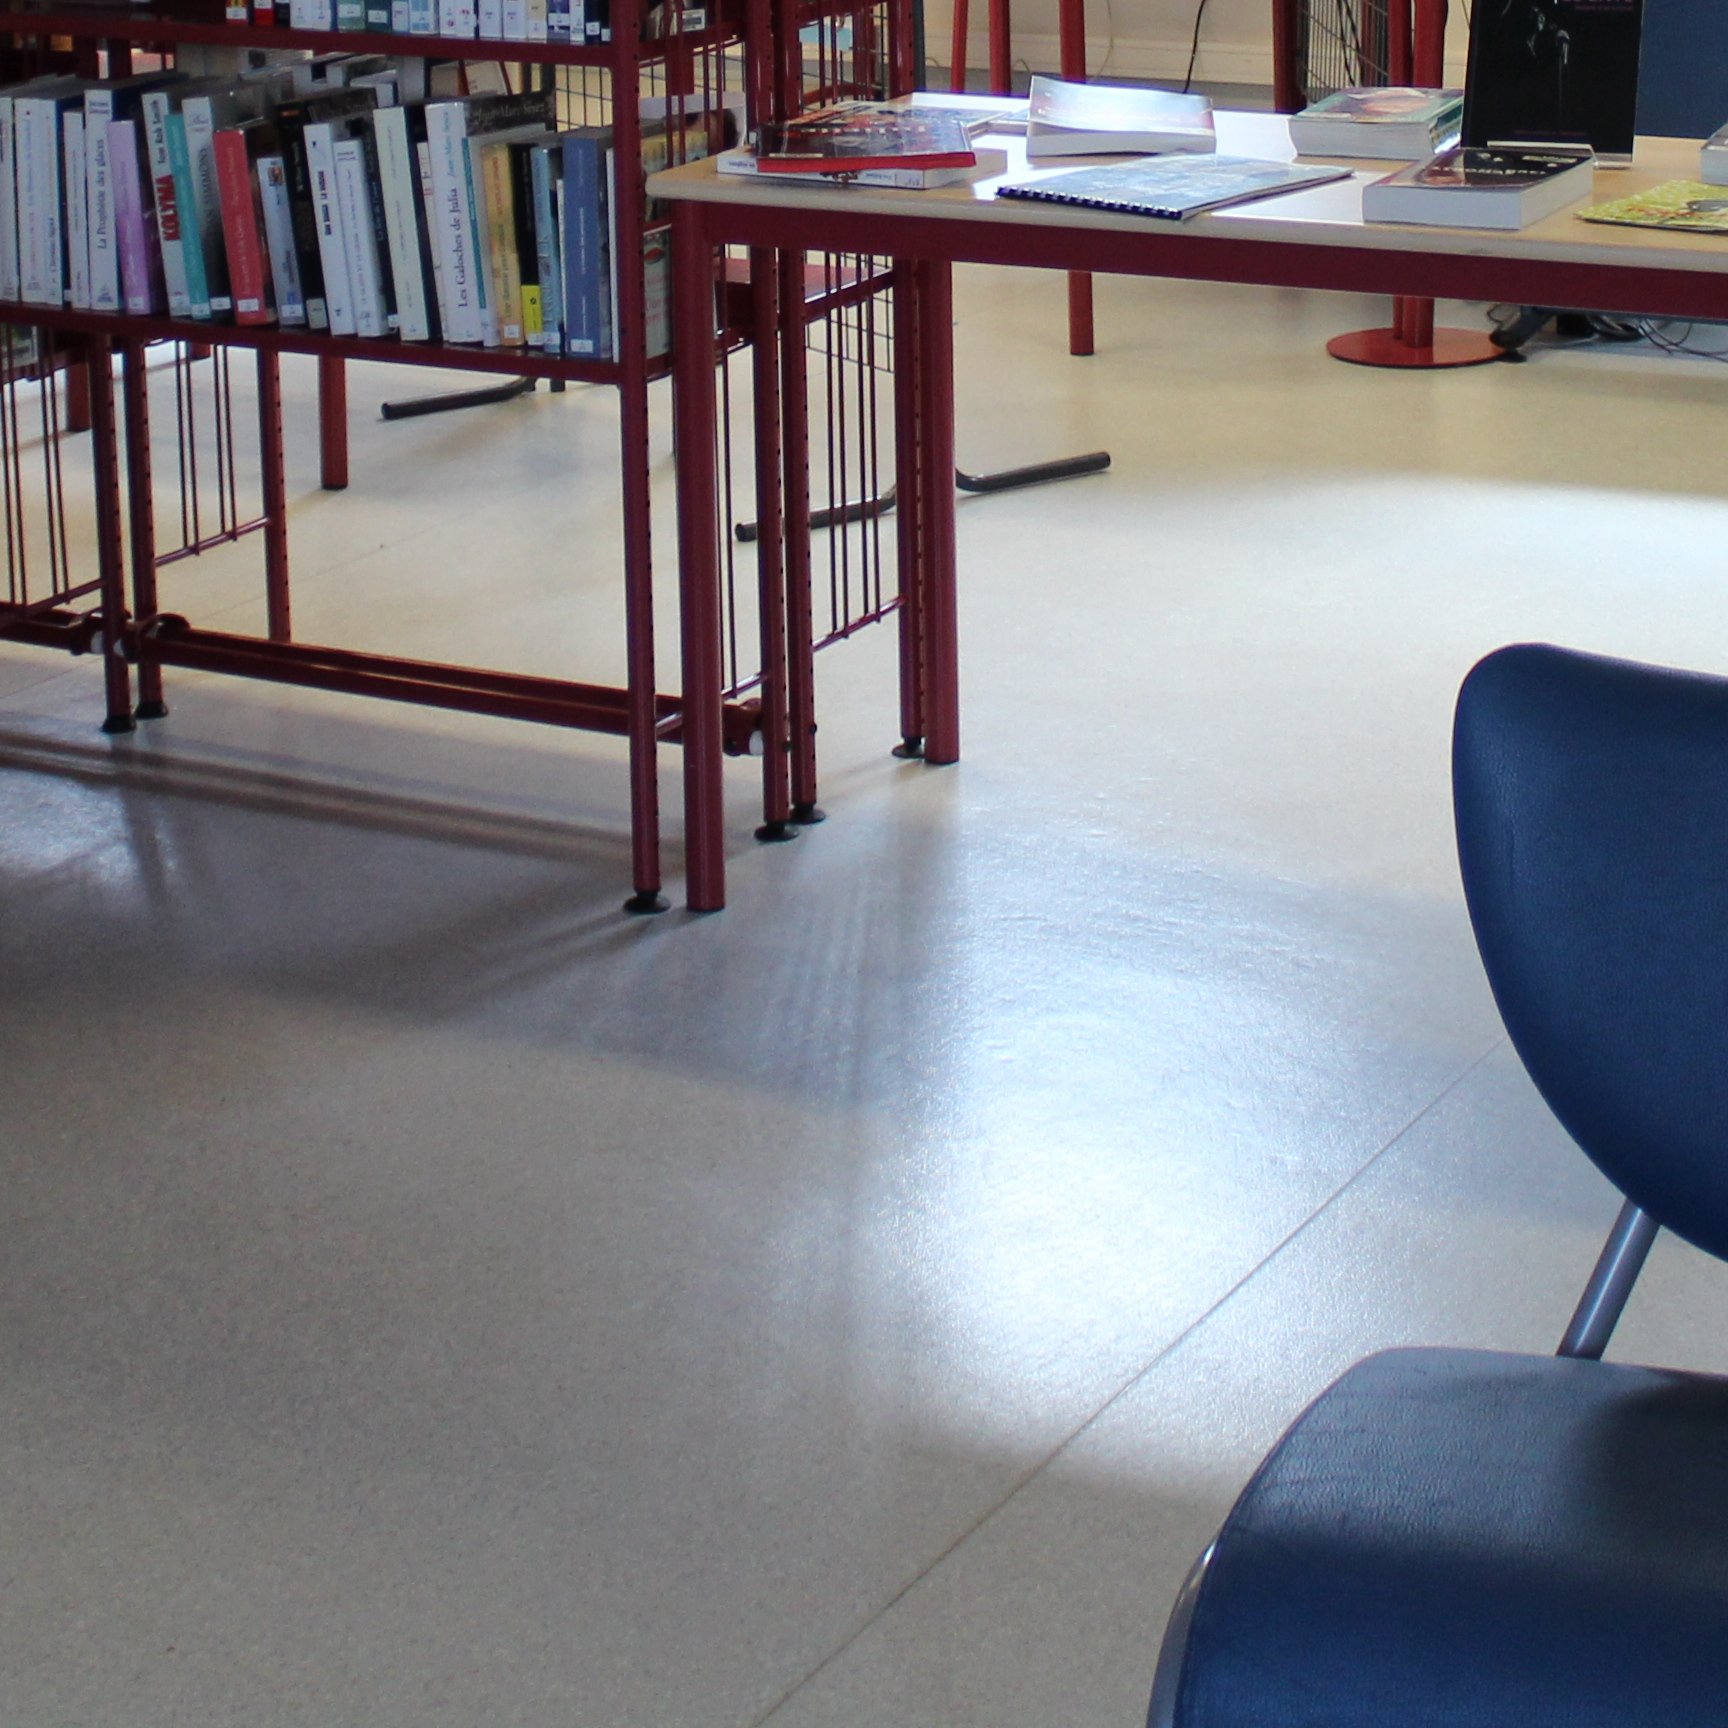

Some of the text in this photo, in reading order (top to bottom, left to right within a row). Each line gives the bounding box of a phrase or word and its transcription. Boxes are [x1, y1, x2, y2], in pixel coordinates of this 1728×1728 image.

[93, 138, 109, 249] La Prophétie des glaces
[155, 174, 181, 241] KOLYMA
[446, 187, 469, 308] Les Galoches de Julia
